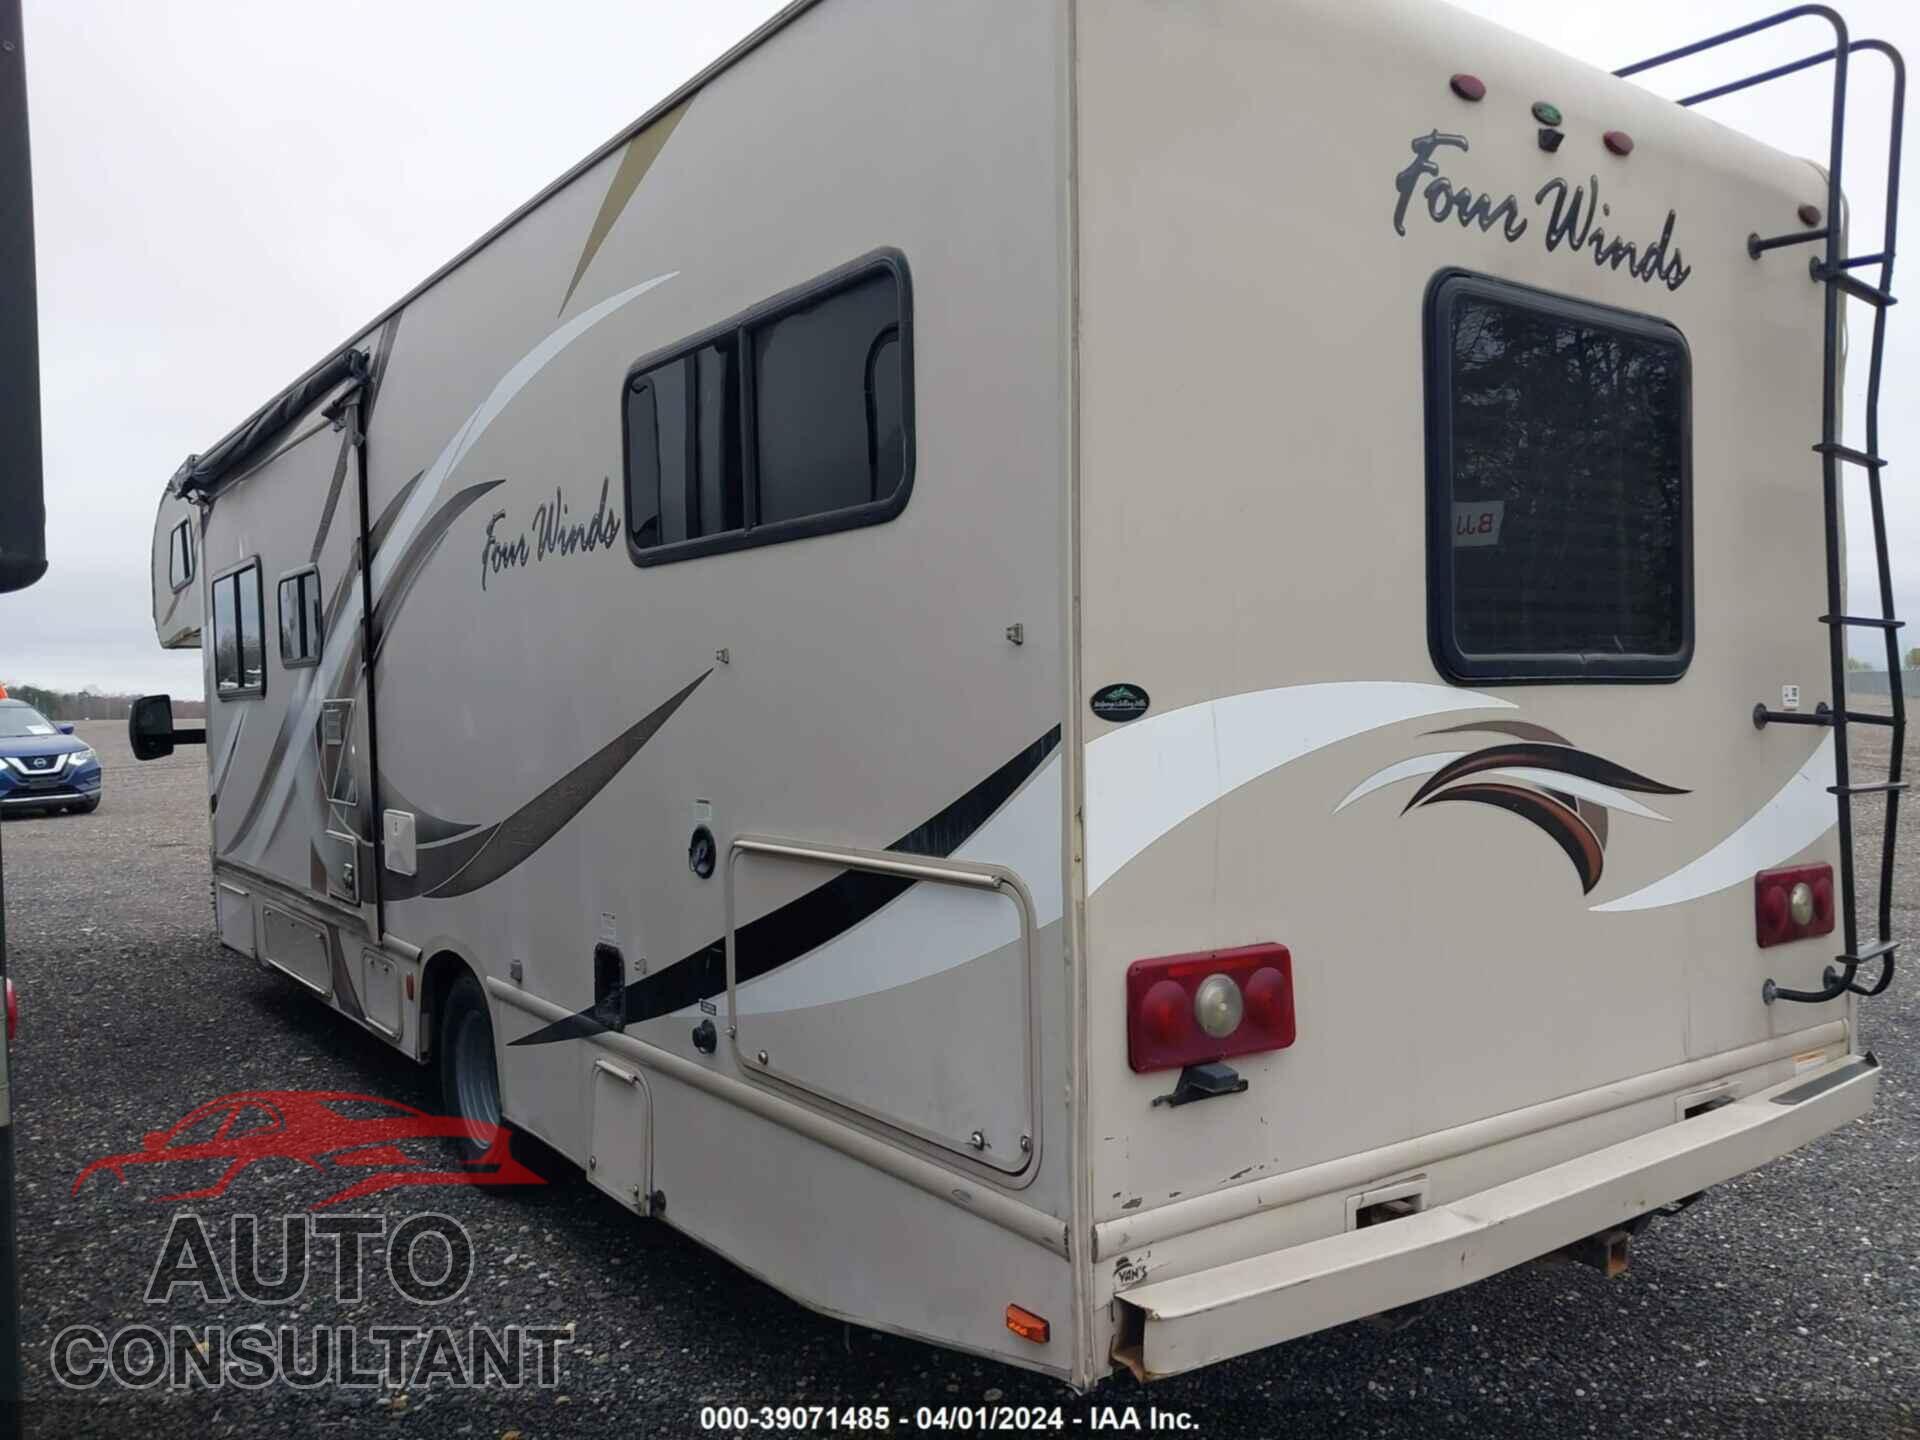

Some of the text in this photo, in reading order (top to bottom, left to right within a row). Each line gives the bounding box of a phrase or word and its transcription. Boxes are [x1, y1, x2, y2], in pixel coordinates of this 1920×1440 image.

[1393, 128, 1691, 291] Four Winds
[481, 476, 621, 591] Four Winds
